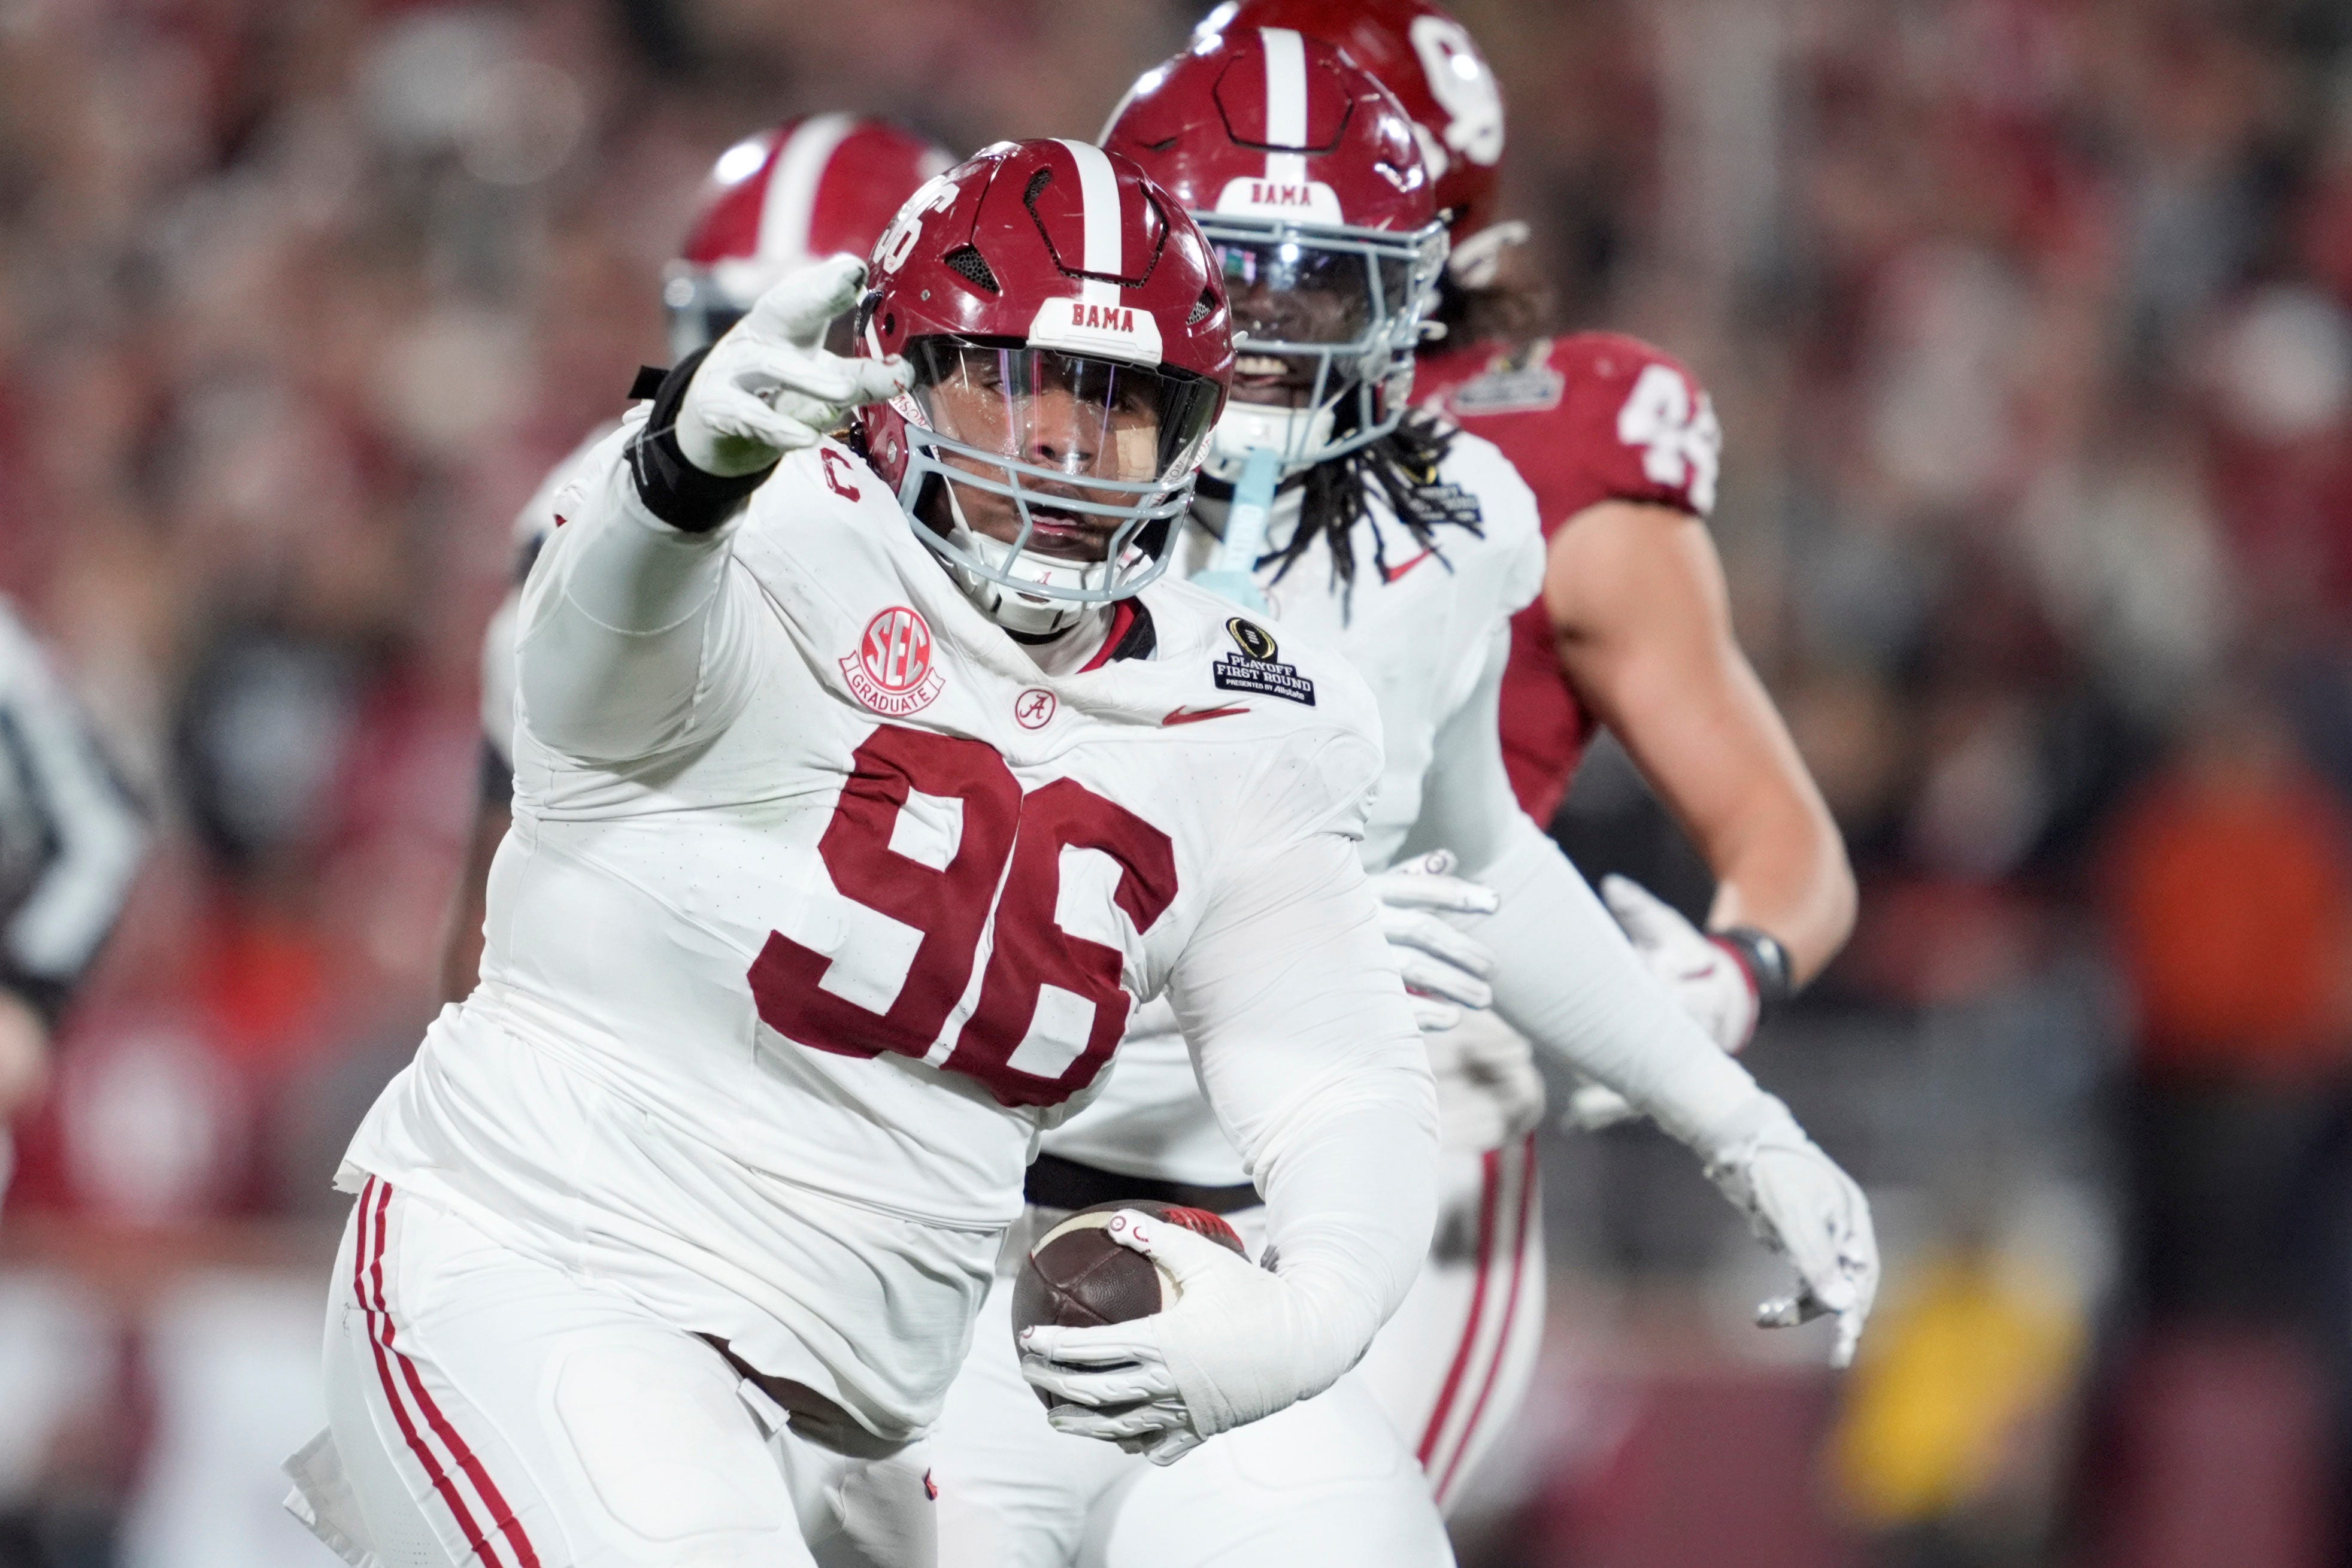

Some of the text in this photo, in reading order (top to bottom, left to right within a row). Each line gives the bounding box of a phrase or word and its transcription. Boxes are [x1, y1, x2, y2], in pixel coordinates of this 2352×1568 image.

[1250, 183, 1312, 205] BAMA
[1071, 304, 1134, 333] BAMA
[820, 447, 860, 503] C
[866, 610, 928, 687] SEC
[1216, 664, 1311, 692] FIRST ROUND
[1230, 655, 1293, 676] PLAYOFF
[852, 674, 930, 712] GRADUATE
[1226, 678, 1263, 689] PRESENTED
[1274, 685, 1305, 700] Allstate
[747, 723, 1178, 1108] 96
